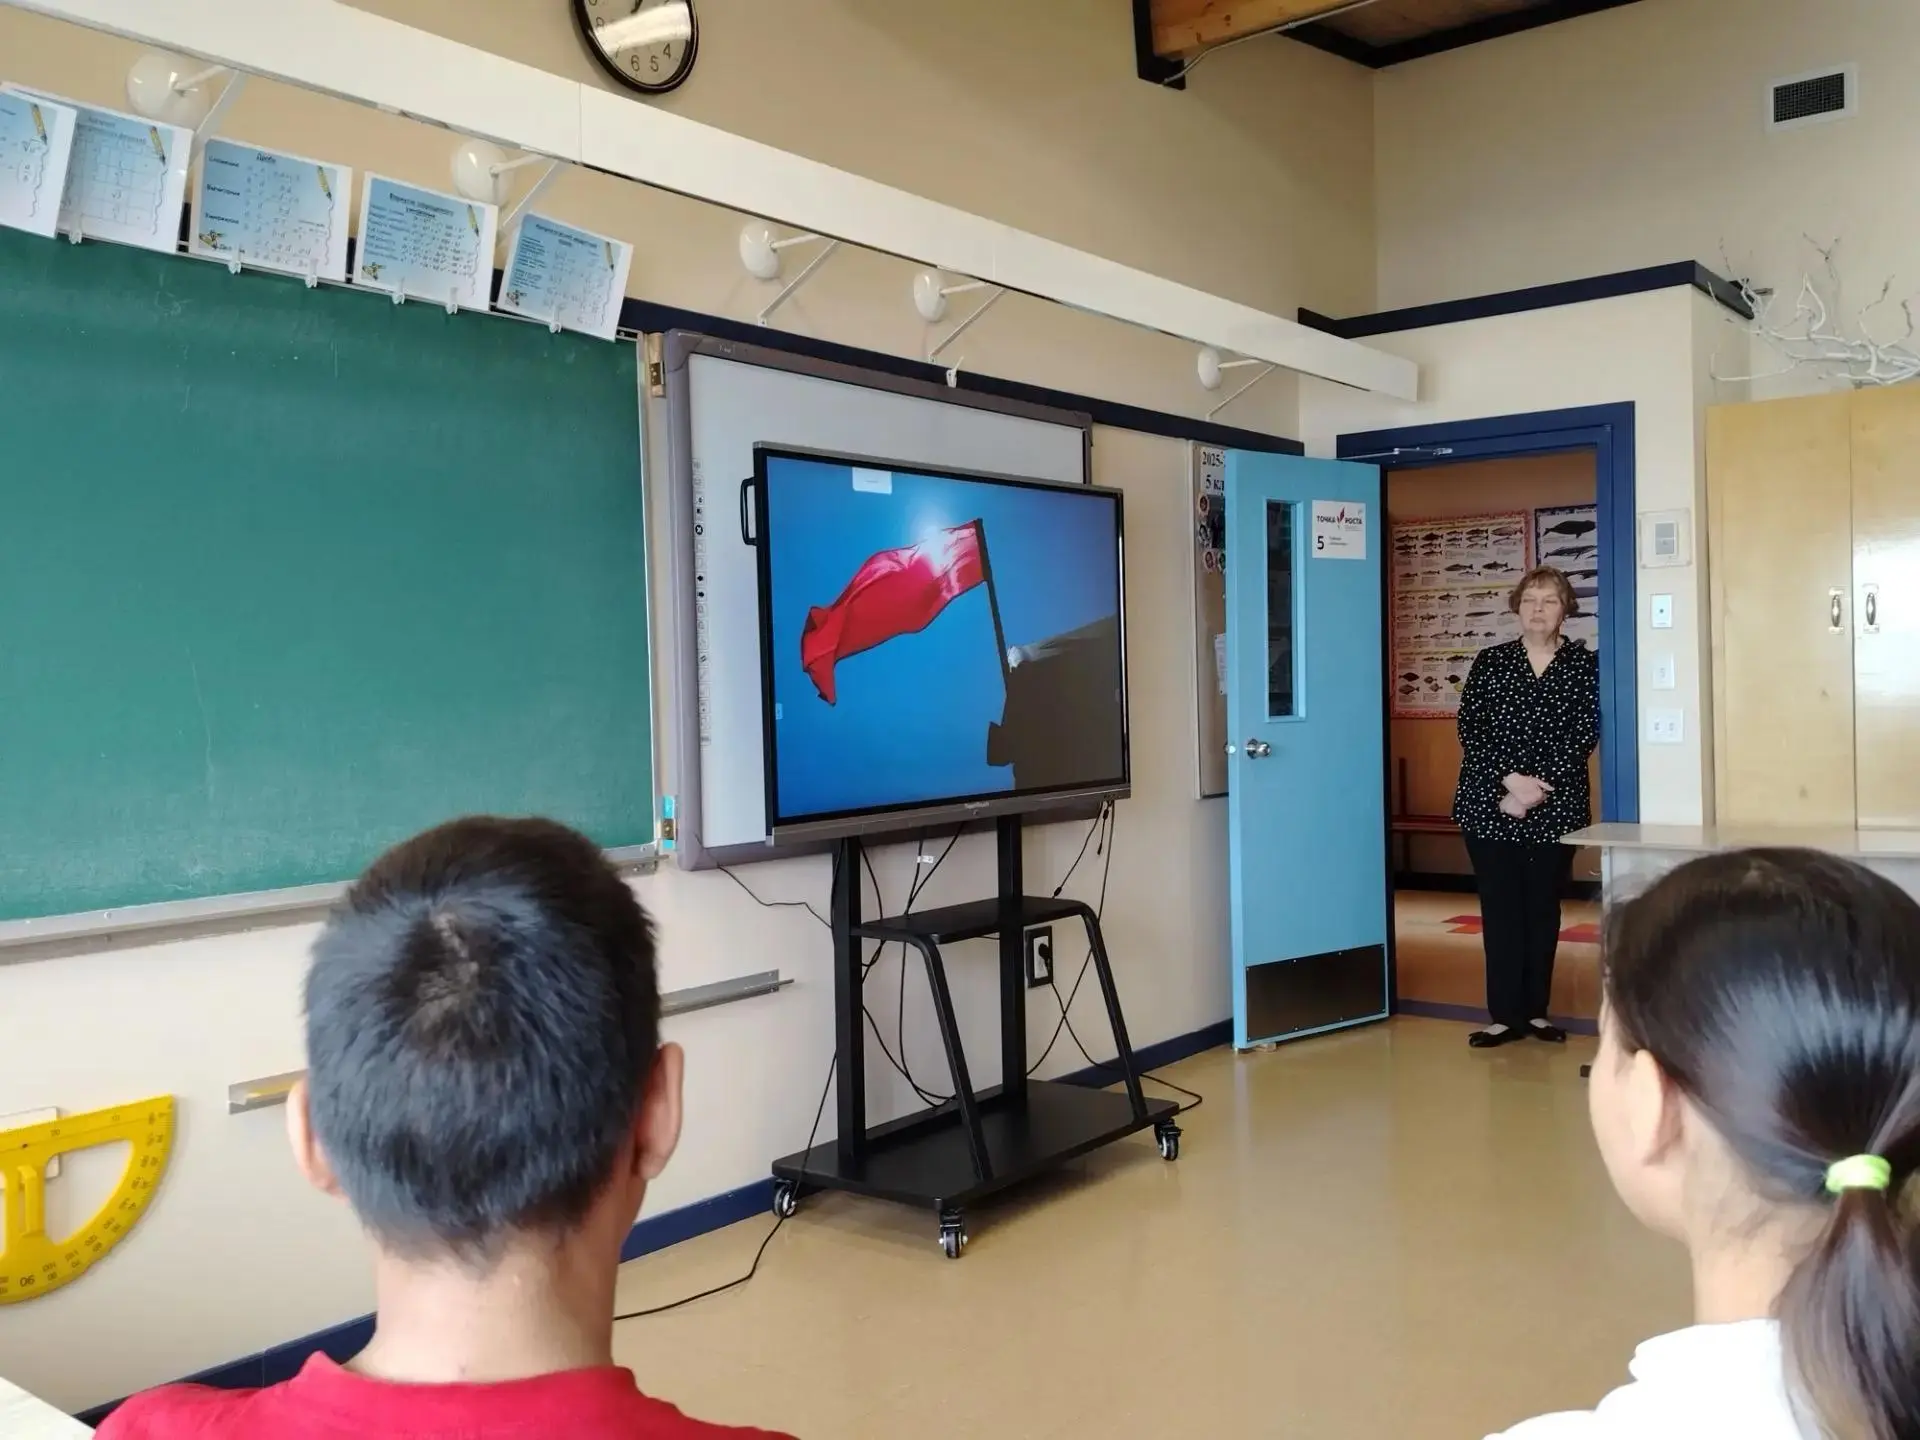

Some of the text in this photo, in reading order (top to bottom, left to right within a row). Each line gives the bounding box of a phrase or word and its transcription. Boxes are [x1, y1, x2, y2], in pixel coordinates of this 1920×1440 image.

[663, 43, 672, 59] 4
[631, 54, 640, 72] 6
[650, 55, 659, 72] 5
[1202, 451, 1226, 467] 2025-
[1206, 474, 1212, 489] 5
[1316, 515, 1363, 525] ТОЧКА РОСТА
[1317, 535, 1325, 550] 5
